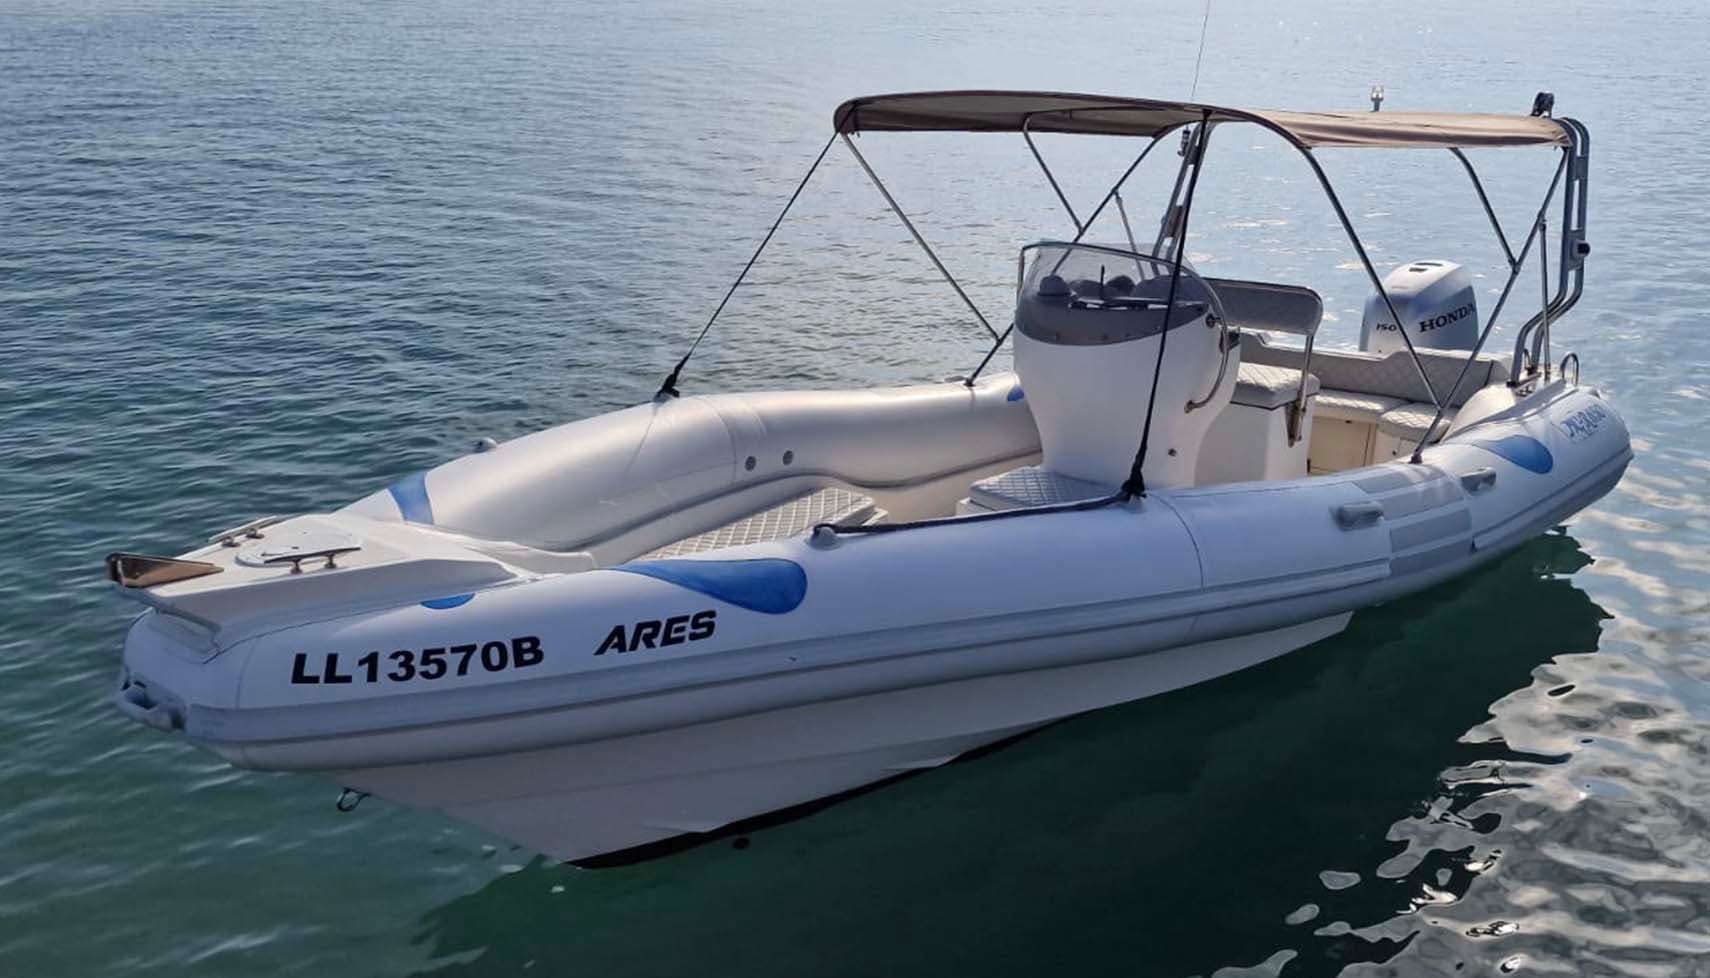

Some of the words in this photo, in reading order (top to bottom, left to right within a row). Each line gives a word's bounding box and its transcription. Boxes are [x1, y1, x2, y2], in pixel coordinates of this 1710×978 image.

[1419, 303, 1475, 333] HONDA
[593, 609, 717, 657] ARES
[290, 635, 545, 685] LL13570B
